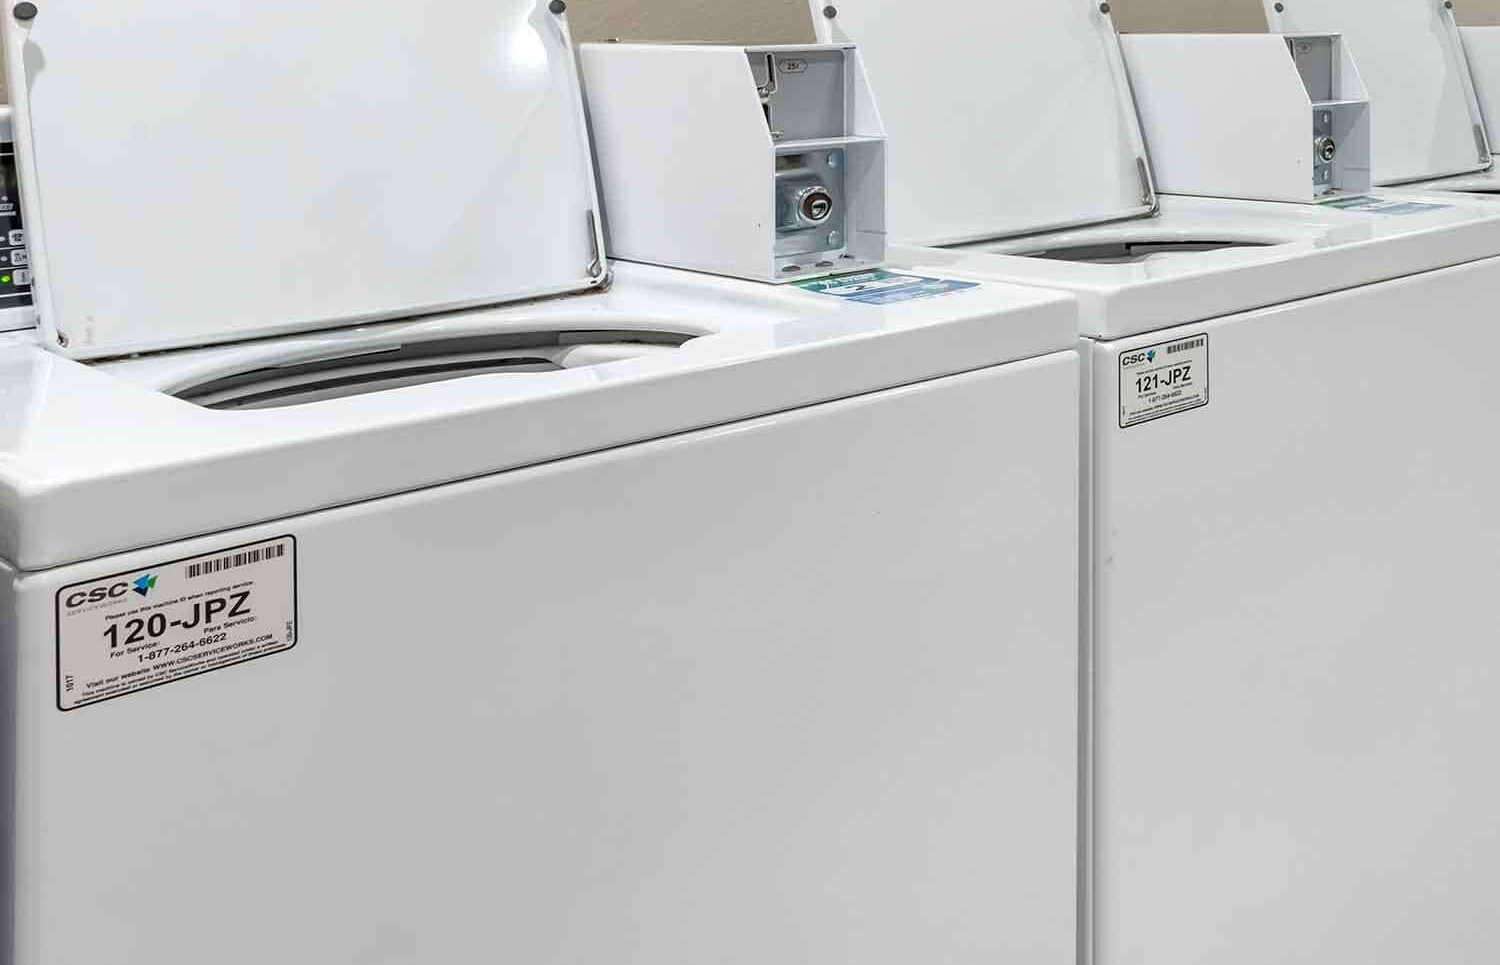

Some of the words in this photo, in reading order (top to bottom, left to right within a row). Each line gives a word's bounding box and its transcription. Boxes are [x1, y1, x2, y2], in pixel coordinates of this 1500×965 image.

[1122, 352, 1146, 366] CSC
[1136, 365, 1192, 393] 121-JPZ
[65, 582, 128, 608] CSC
[103, 590, 251, 648] 120-JPZ
[203, 624, 222, 634] Para
[110, 650, 124, 659] For
[138, 633, 227, 663] 1-877-264-6622
[65, 675, 74, 692] 1017
